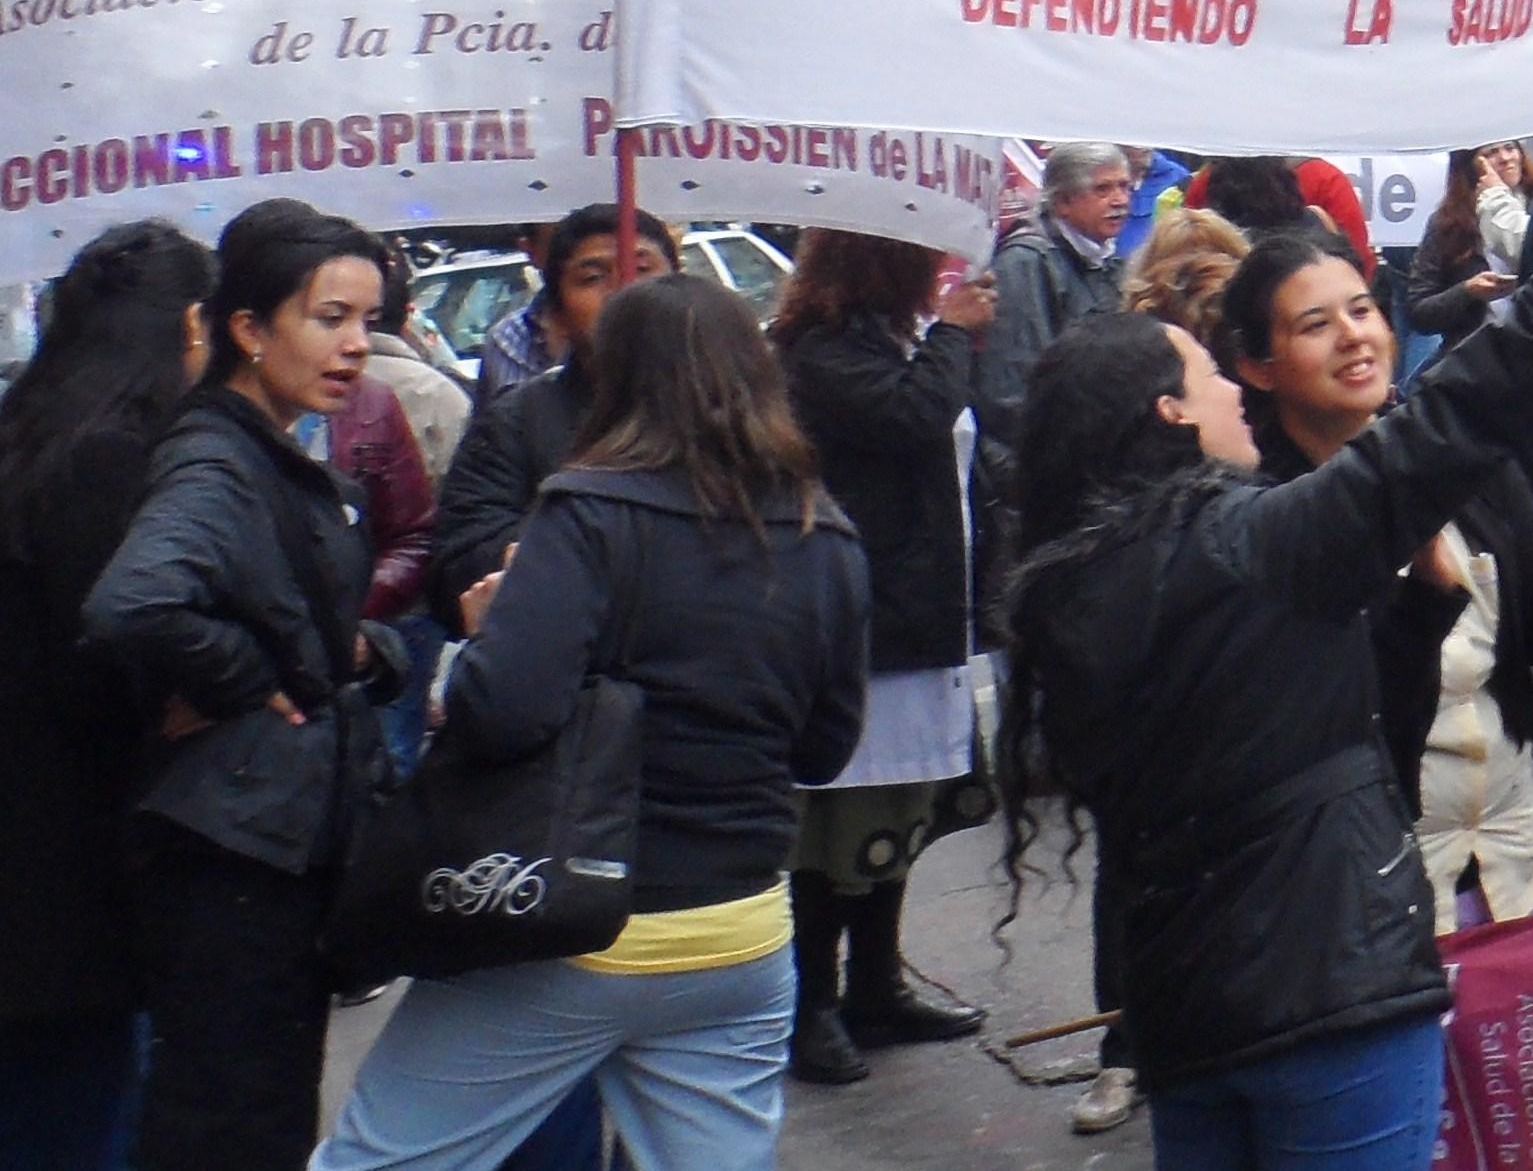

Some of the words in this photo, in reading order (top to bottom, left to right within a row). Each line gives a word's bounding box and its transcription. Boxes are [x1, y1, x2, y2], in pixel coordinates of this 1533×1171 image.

[249, 22, 314, 65] de
[335, 16, 388, 60] la
[412, 10, 552, 56] Pcia.
[579, 10, 618, 54] d
[0, 125, 242, 212] CCIONAL
[256, 107, 536, 175] HOSPITAL
[869, 130, 907, 181] de
